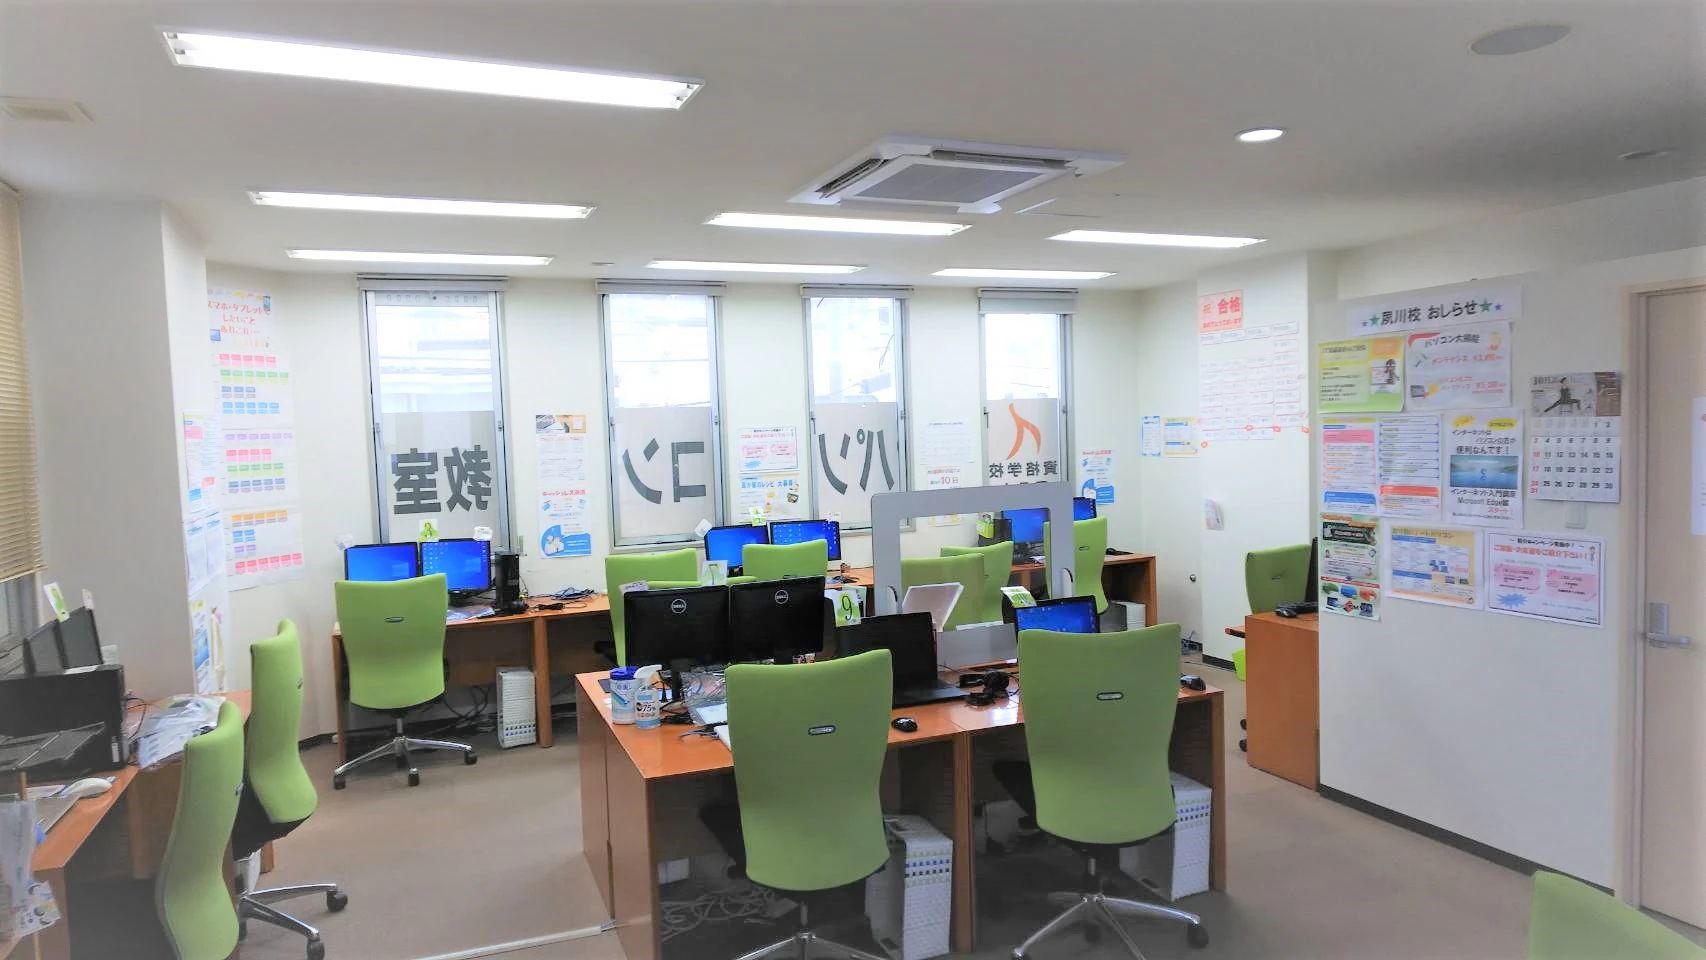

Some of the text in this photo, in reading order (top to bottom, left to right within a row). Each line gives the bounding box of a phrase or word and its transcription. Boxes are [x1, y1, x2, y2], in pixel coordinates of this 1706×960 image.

[1217, 296, 1241, 315] 合格
[1381, 301, 1478, 326] 夙川校 おしらせ
[1606, 451, 1614, 459] 16
[1579, 481, 1588, 489] 28
[841, 595, 853, 621] 9
